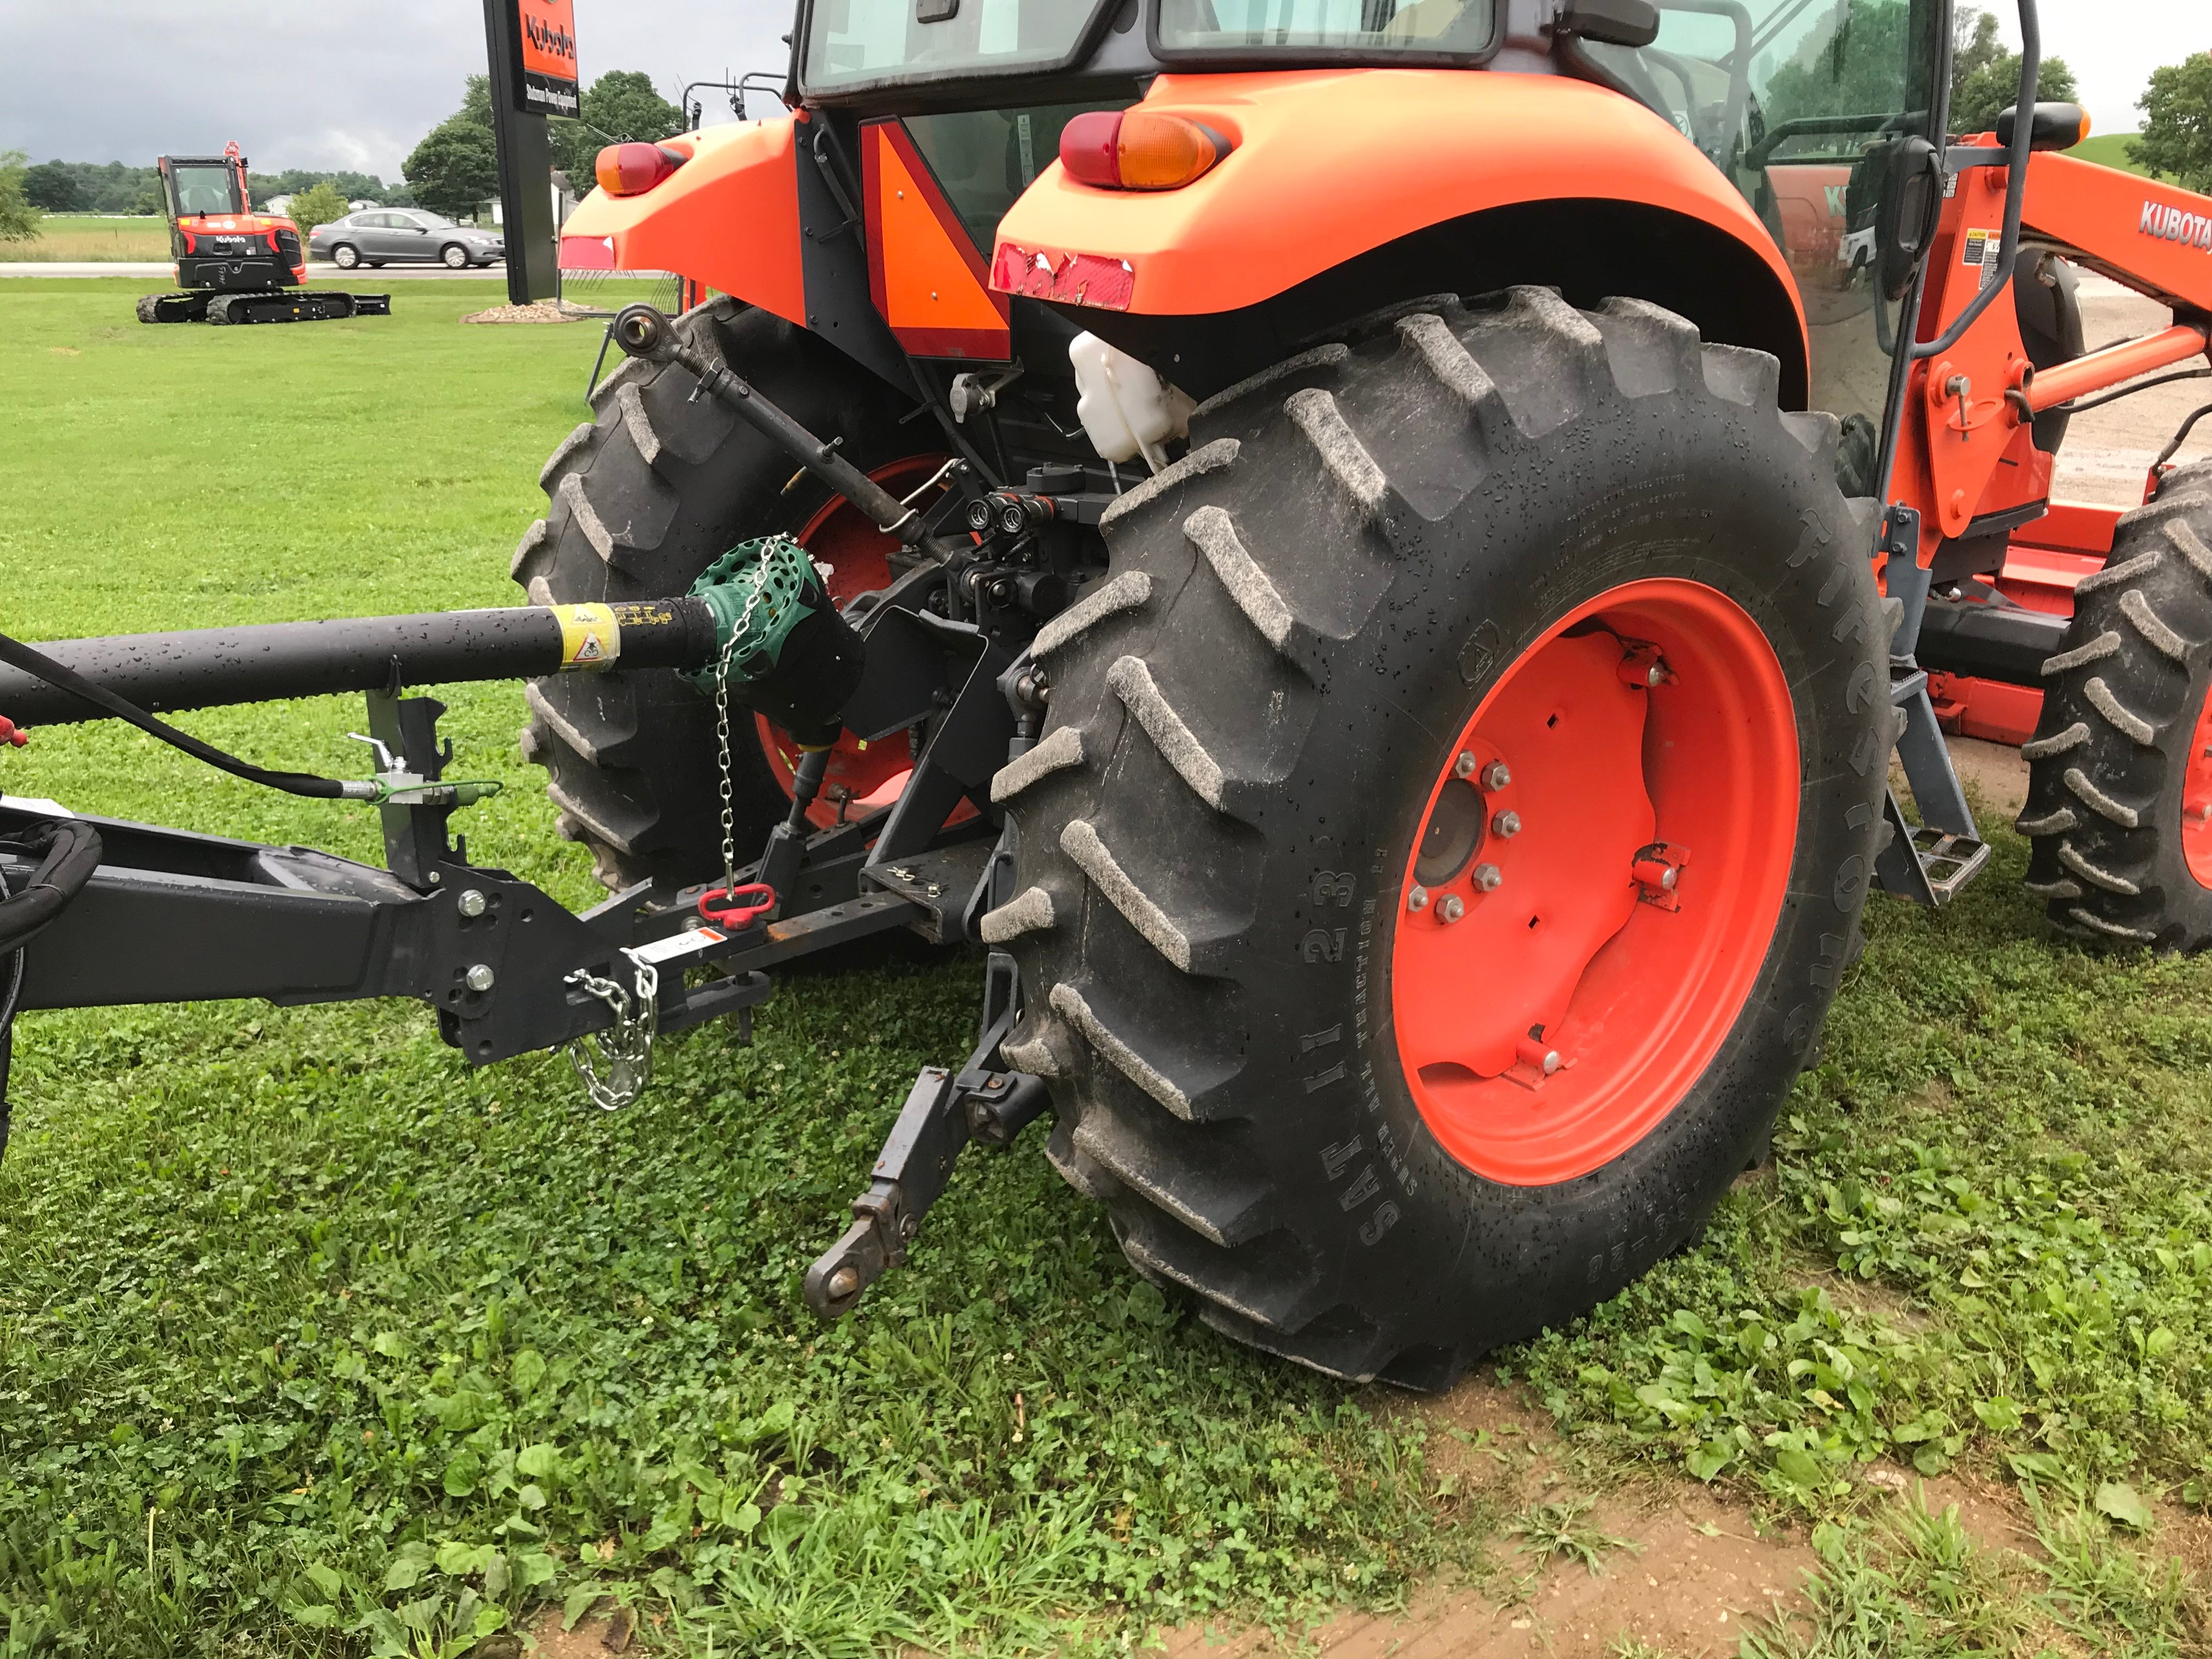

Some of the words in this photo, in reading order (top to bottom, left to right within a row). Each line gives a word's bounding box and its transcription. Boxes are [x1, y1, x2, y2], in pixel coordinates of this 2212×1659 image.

[525, 13, 574, 60] Kubota
[2138, 200, 2212, 251] KUBOTA
[1355, 899, 1377, 1049] TRACTION
[1361, 1060, 1381, 1113] ALL
[1317, 1133, 1400, 1246] SAT
